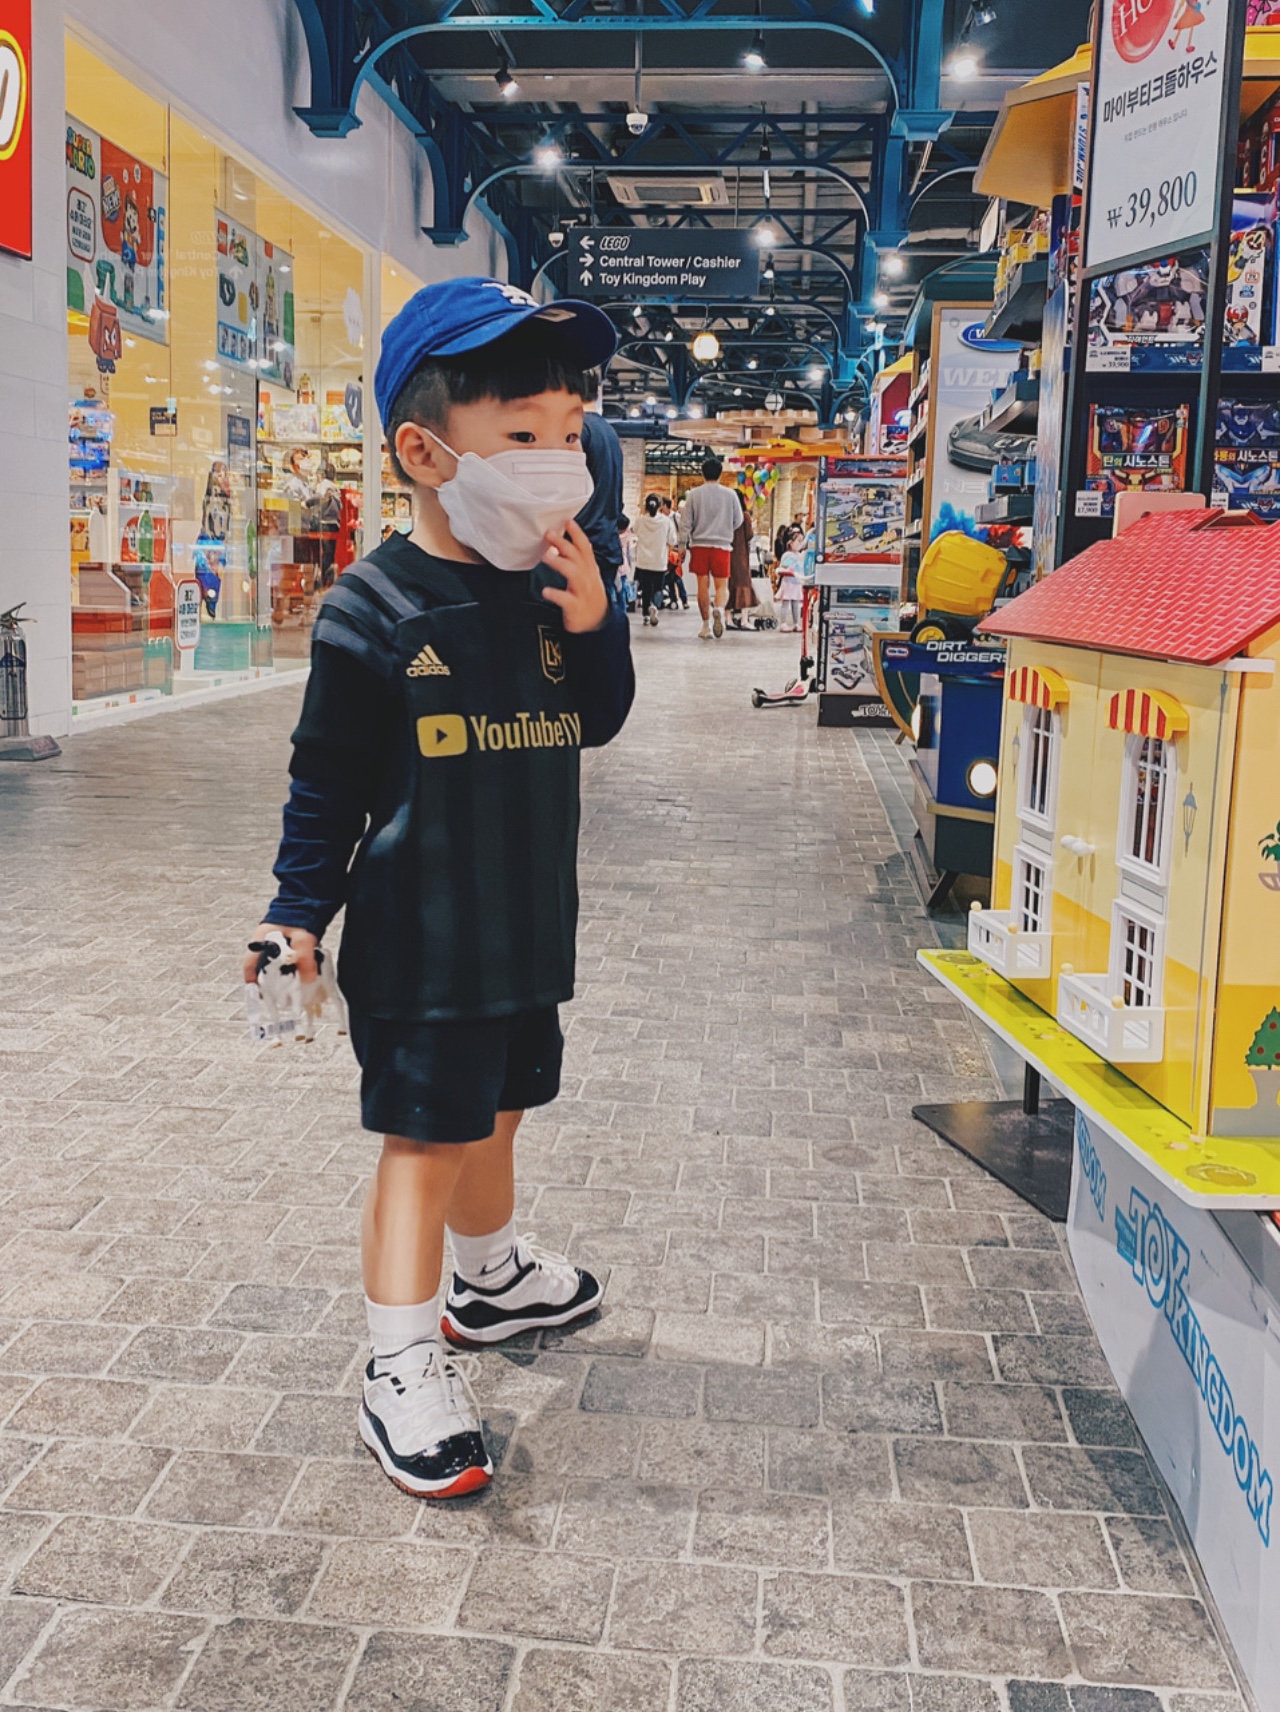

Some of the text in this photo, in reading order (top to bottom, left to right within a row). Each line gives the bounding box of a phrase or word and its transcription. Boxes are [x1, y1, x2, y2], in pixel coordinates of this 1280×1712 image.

[1103, 50, 1218, 123] 마이부티크돌하우스
[66, 126, 93, 156] SUPER
[65, 142, 96, 180] MARIO
[599, 235, 631, 251] LEGO
[599, 255, 645, 267] Central
[646, 255, 685, 268] Tower
[693, 256, 742, 268] Cashier
[599, 272, 707, 287] Toy Kingdom Play
[926, 640, 968, 651] DIRT
[405, 664, 451, 677] adidas
[1129, 1185, 1190, 1322] TOY
[1167, 1302, 1274, 1549] KINGDOM
